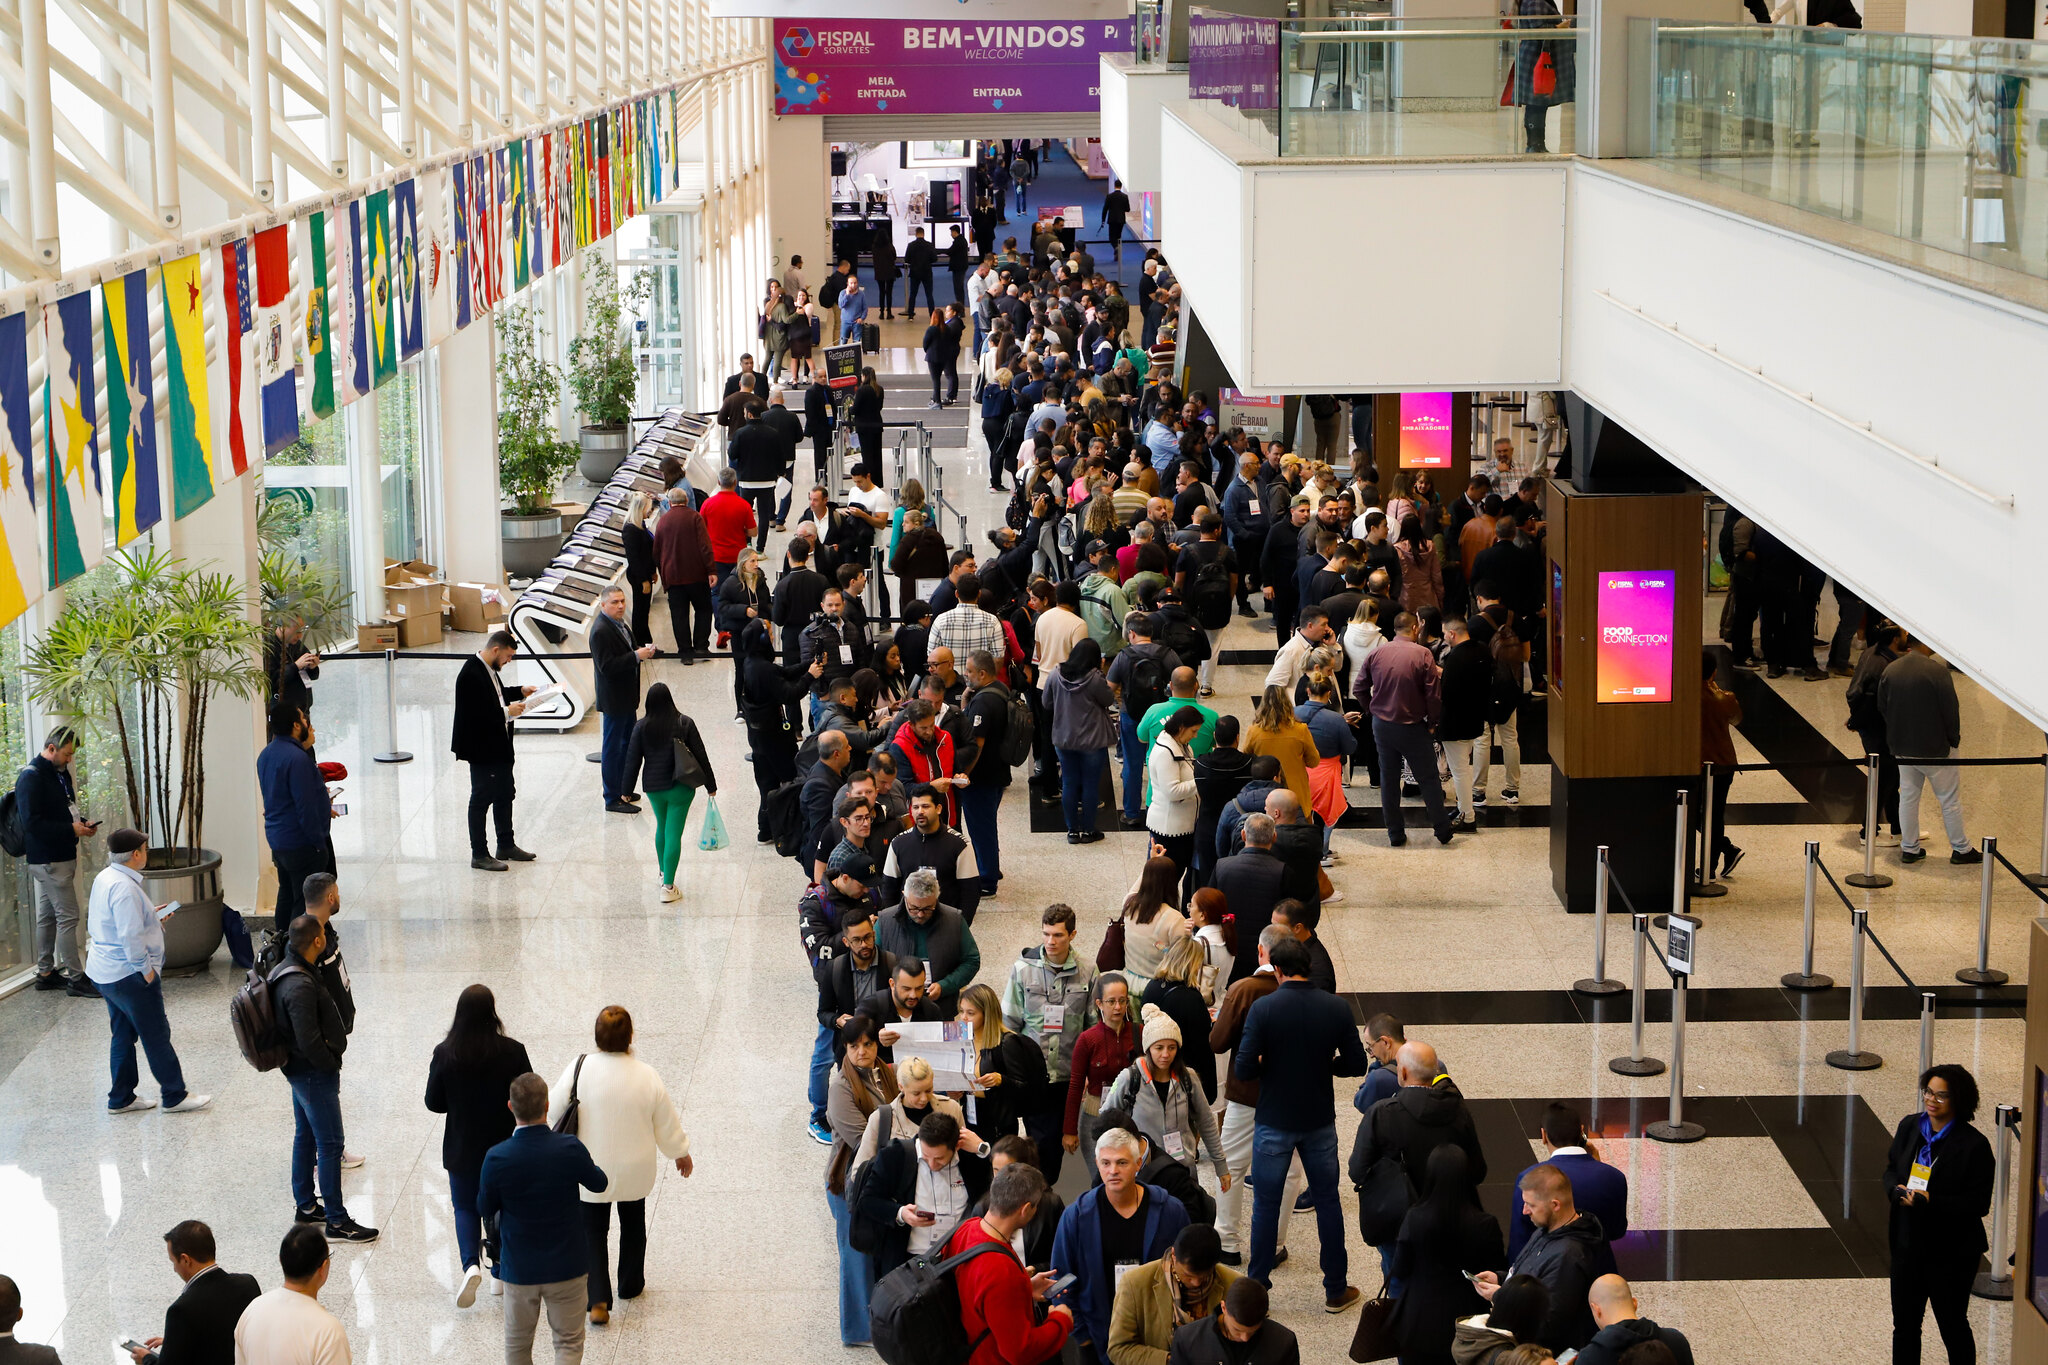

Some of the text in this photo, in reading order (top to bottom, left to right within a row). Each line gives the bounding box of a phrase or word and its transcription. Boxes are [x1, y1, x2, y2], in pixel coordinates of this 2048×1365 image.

[818, 31, 875, 47] FISPAL
[903, 25, 1086, 49] BEM-VINDOS
[824, 46, 870, 55] SORVETES
[965, 48, 1024, 60] WELCOME
[869, 76, 895, 86] MEIA
[857, 88, 907, 98] ENTRADA
[973, 87, 1022, 97] ENTRADA
[1603, 627, 1633, 635] FOOD
[1603, 634, 1668, 644] CONNECTION
